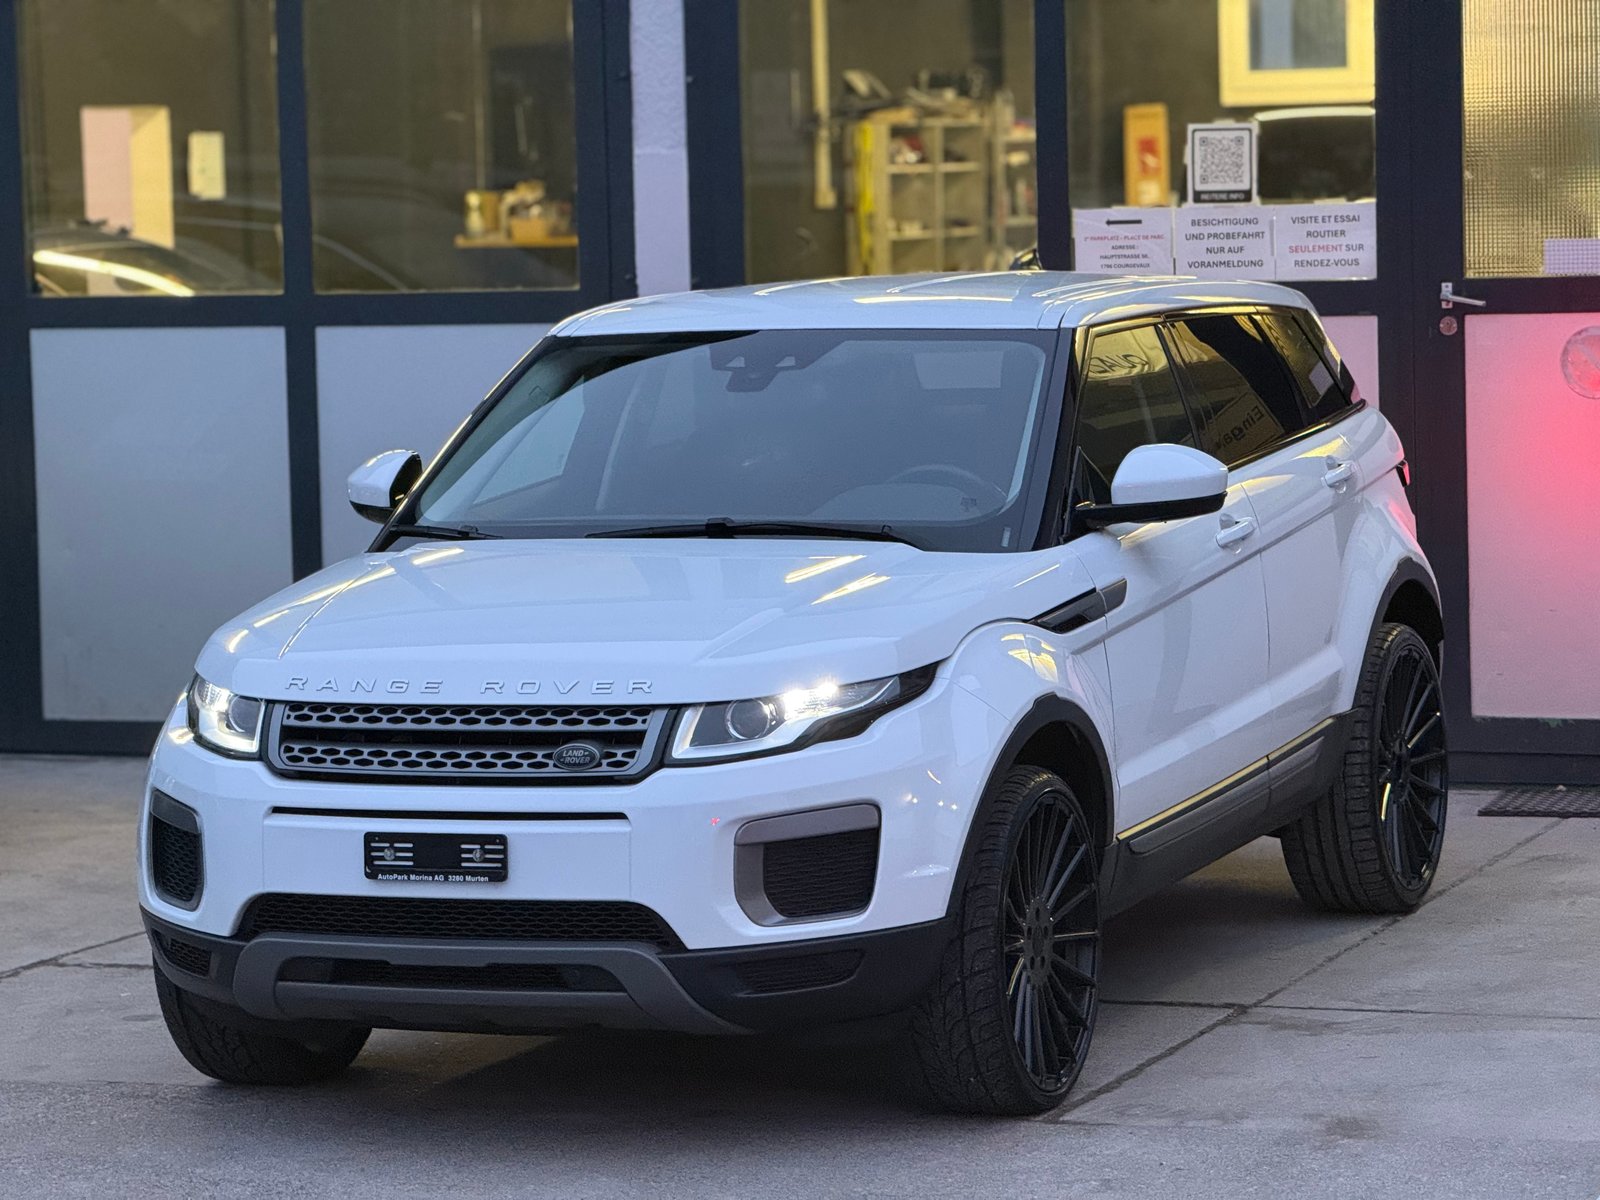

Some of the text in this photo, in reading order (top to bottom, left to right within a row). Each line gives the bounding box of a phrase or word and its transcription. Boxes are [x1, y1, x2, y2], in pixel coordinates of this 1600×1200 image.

[1229, 192, 1245, 200] INFO
[1191, 217, 1259, 227] BESICHTIGUNG
[1291, 214, 1360, 224] VISITE ET ESSAI
[1207, 231, 1265, 240] PROBEFAHRT
[1306, 229, 1346, 238] ROUTIER
[1206, 245, 1245, 254] NUR AUF
[1289, 243, 1364, 253] SEULEMENT SUR
[1187, 259, 1264, 269] VORANMELDUNG
[1294, 258, 1360, 268] RENDEZ-VOUS
[285, 676, 653, 695] RANGE ROVER
[377, 873, 408, 881] AutoPark
